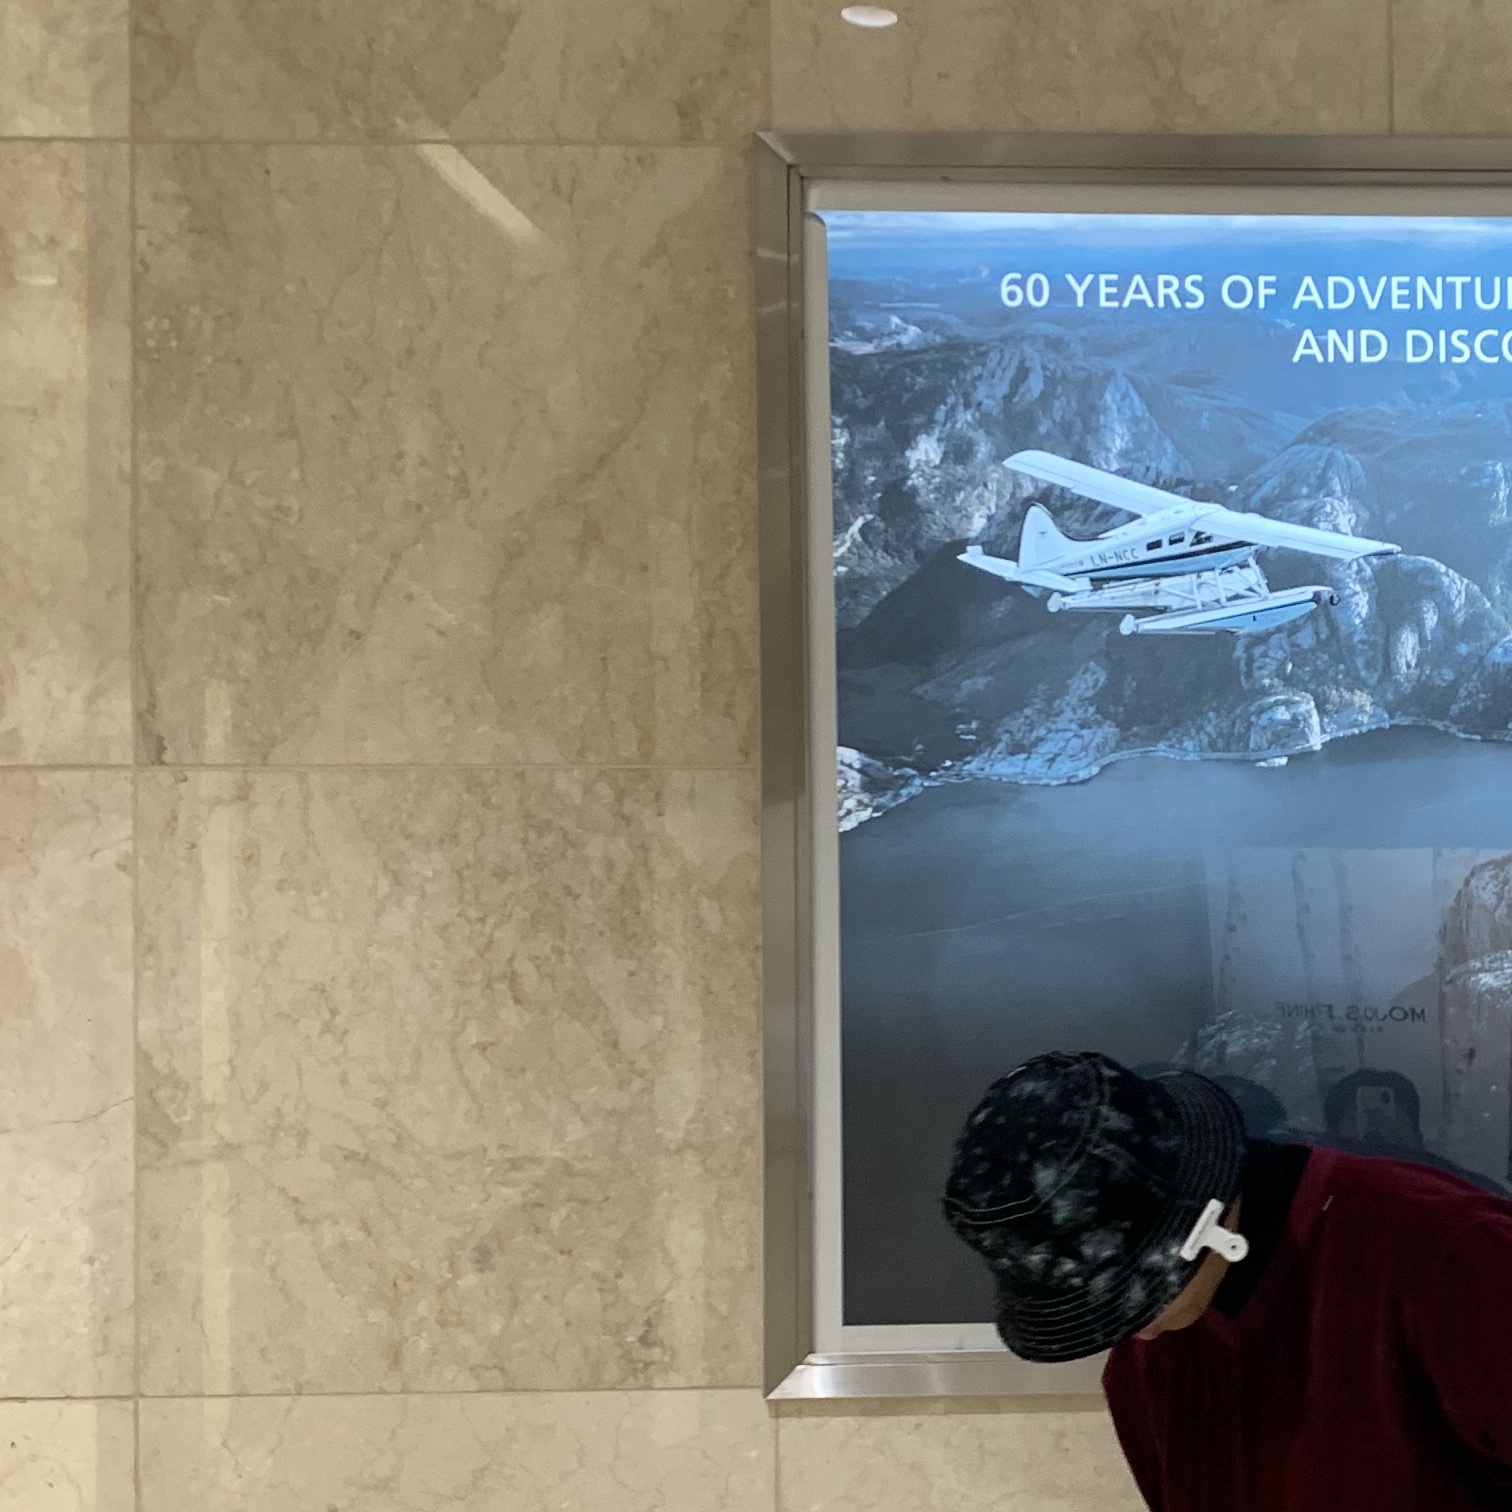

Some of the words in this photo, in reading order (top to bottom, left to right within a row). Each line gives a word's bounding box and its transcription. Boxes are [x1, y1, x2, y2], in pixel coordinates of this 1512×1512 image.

[1000, 272, 1050, 308] 60
[1065, 273, 1204, 309] YEARS
[1221, 274, 1277, 309] OF
[1292, 328, 1388, 363] AND
